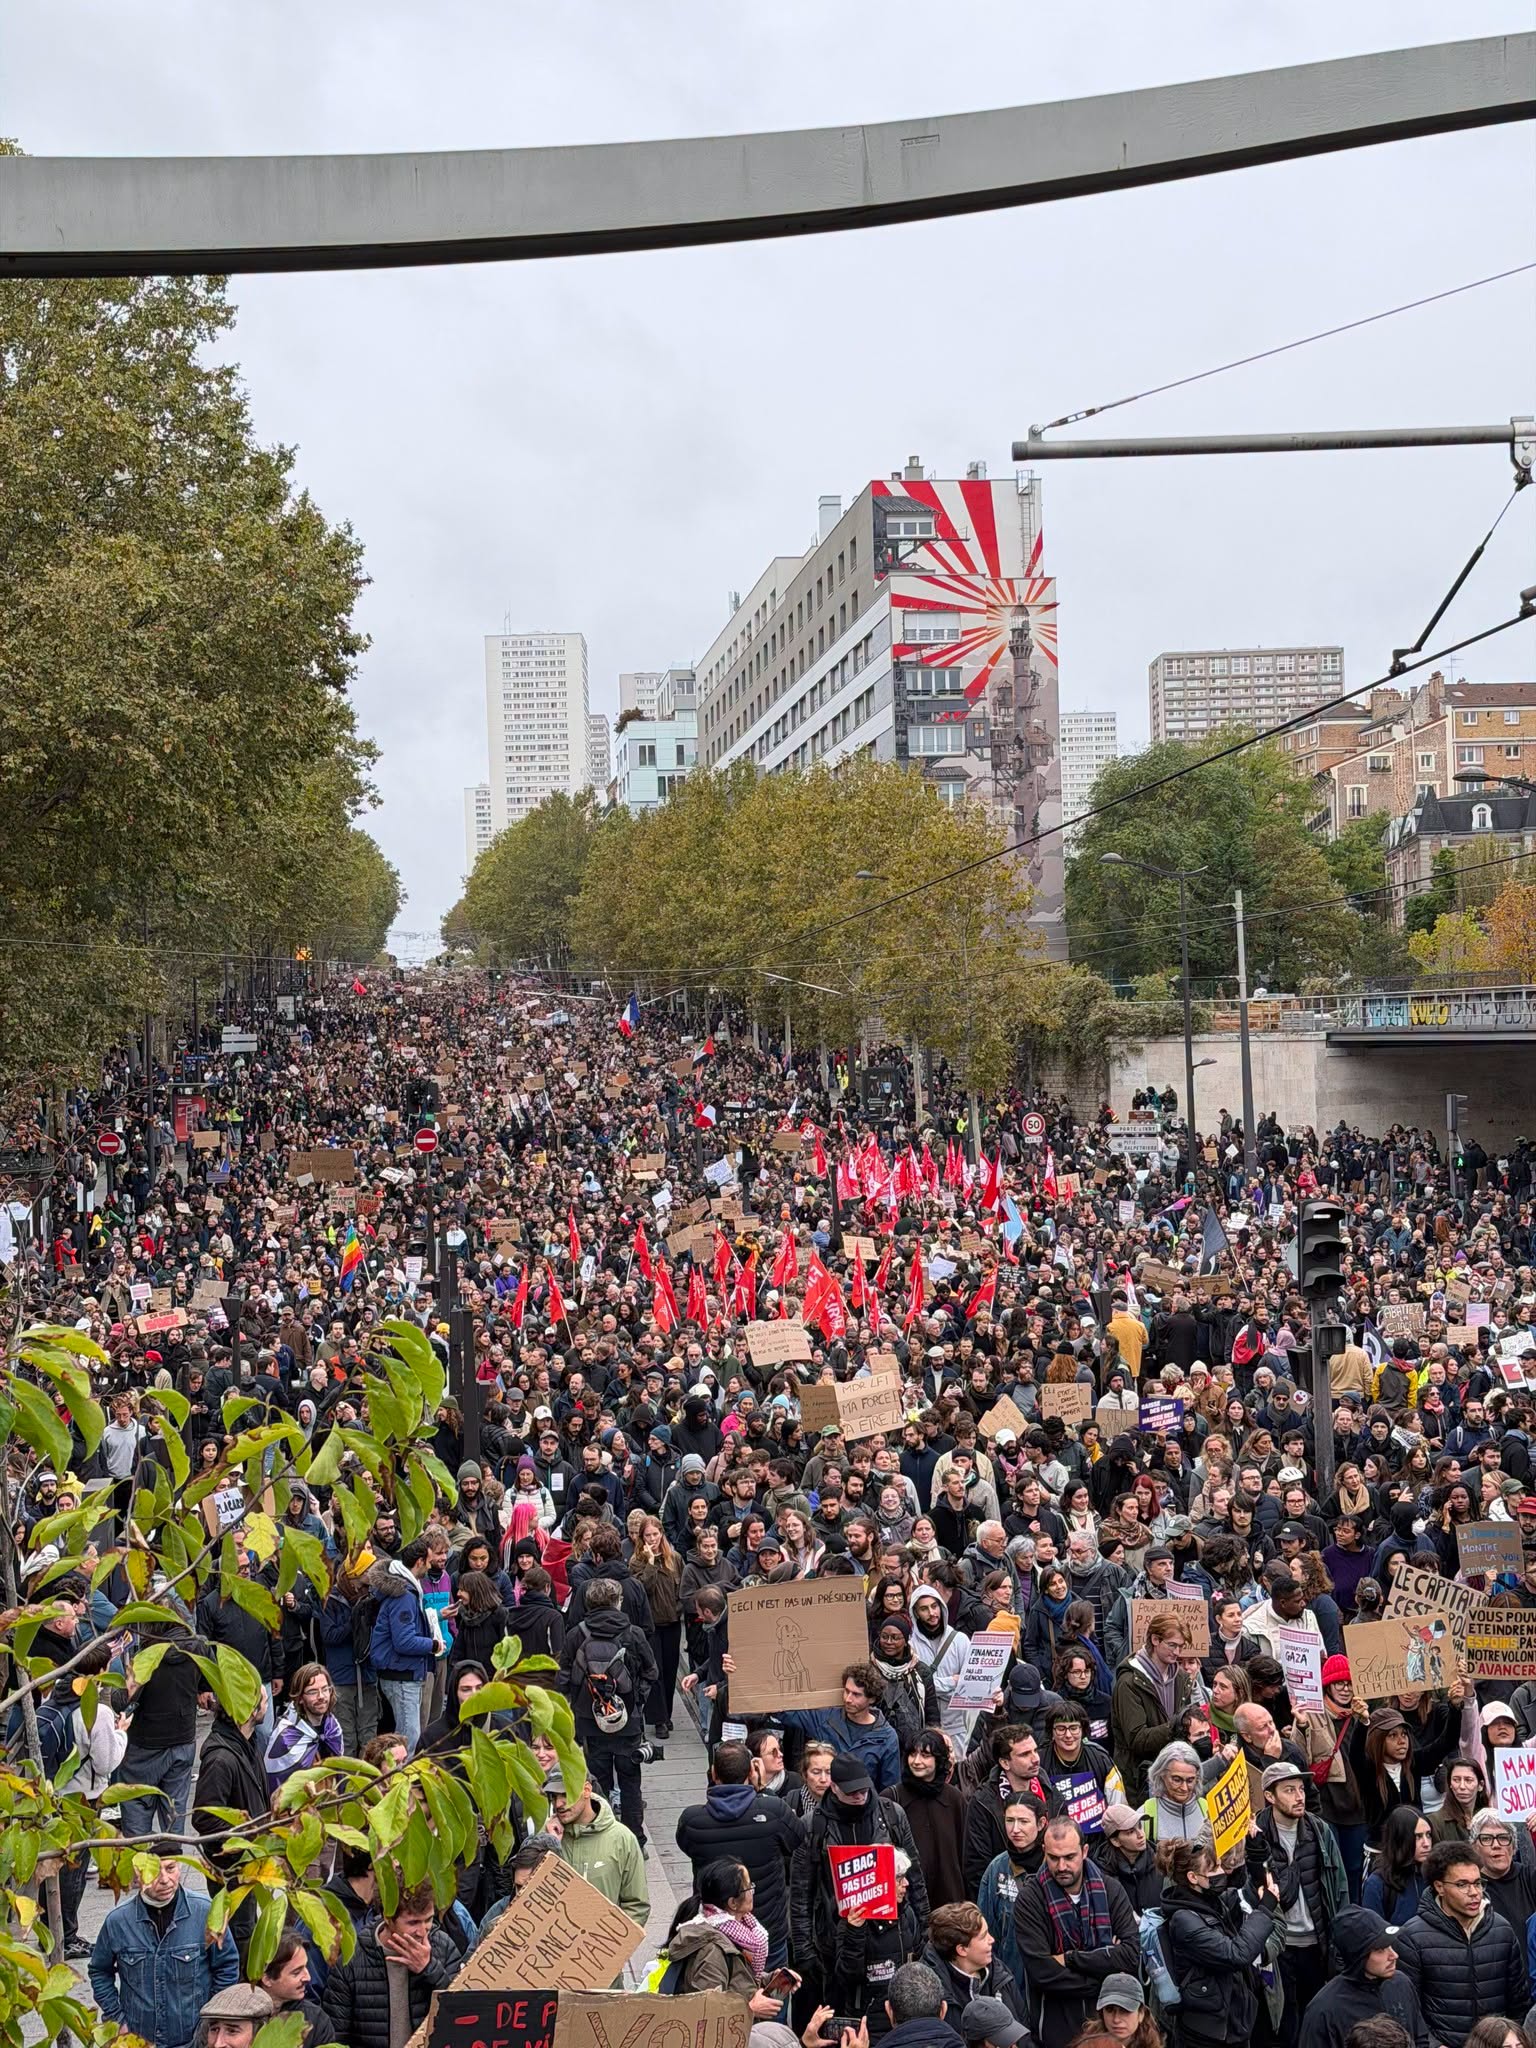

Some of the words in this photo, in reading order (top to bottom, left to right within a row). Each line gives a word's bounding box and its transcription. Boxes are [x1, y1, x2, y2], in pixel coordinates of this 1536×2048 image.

[1028, 1120, 1040, 1129] 50
[842, 1382, 866, 1394] MDR
[870, 1375, 888, 1388] LFI
[842, 1402, 858, 1415] MA
[861, 1393, 890, 1410] FORCE
[1462, 1544, 1497, 1553] MONTRE
[1394, 1565, 1414, 1592] LE
[731, 1601, 753, 1612] CECI
[757, 1599, 779, 1610] N'EST
[784, 1600, 799, 1608] PAS
[802, 1597, 813, 1606] UN
[818, 1591, 863, 1604] PRÉSIDENT
[1139, 1603, 1156, 1613] POUR
[1172, 1604, 1202, 1613] FUTUR
[1469, 1610, 1503, 1622] VOUS
[971, 1649, 1004, 1657] FINANCEZ
[1285, 1651, 1307, 1666] GAZA
[1468, 1649, 1500, 1661] NOTRE
[1468, 1662, 1536, 1676] D'AVANCER
[1073, 1782, 1093, 1798] PRIX
[1081, 1793, 1097, 1808] DES
[1215, 1788, 1230, 1815] LE
[1213, 1816, 1226, 1839] PAS
[1225, 1805, 1236, 1827] LES
[838, 1862, 851, 1878] LE
[853, 1852, 876, 1873] BAC,
[524, 1861, 574, 1922] PEUVENT
[842, 1878, 859, 1895] PAS
[861, 1872, 876, 1888] LES
[477, 1914, 536, 1982] FRANÇAIS
[570, 1909, 629, 1981] MANU
[496, 2001, 529, 2029] DE
